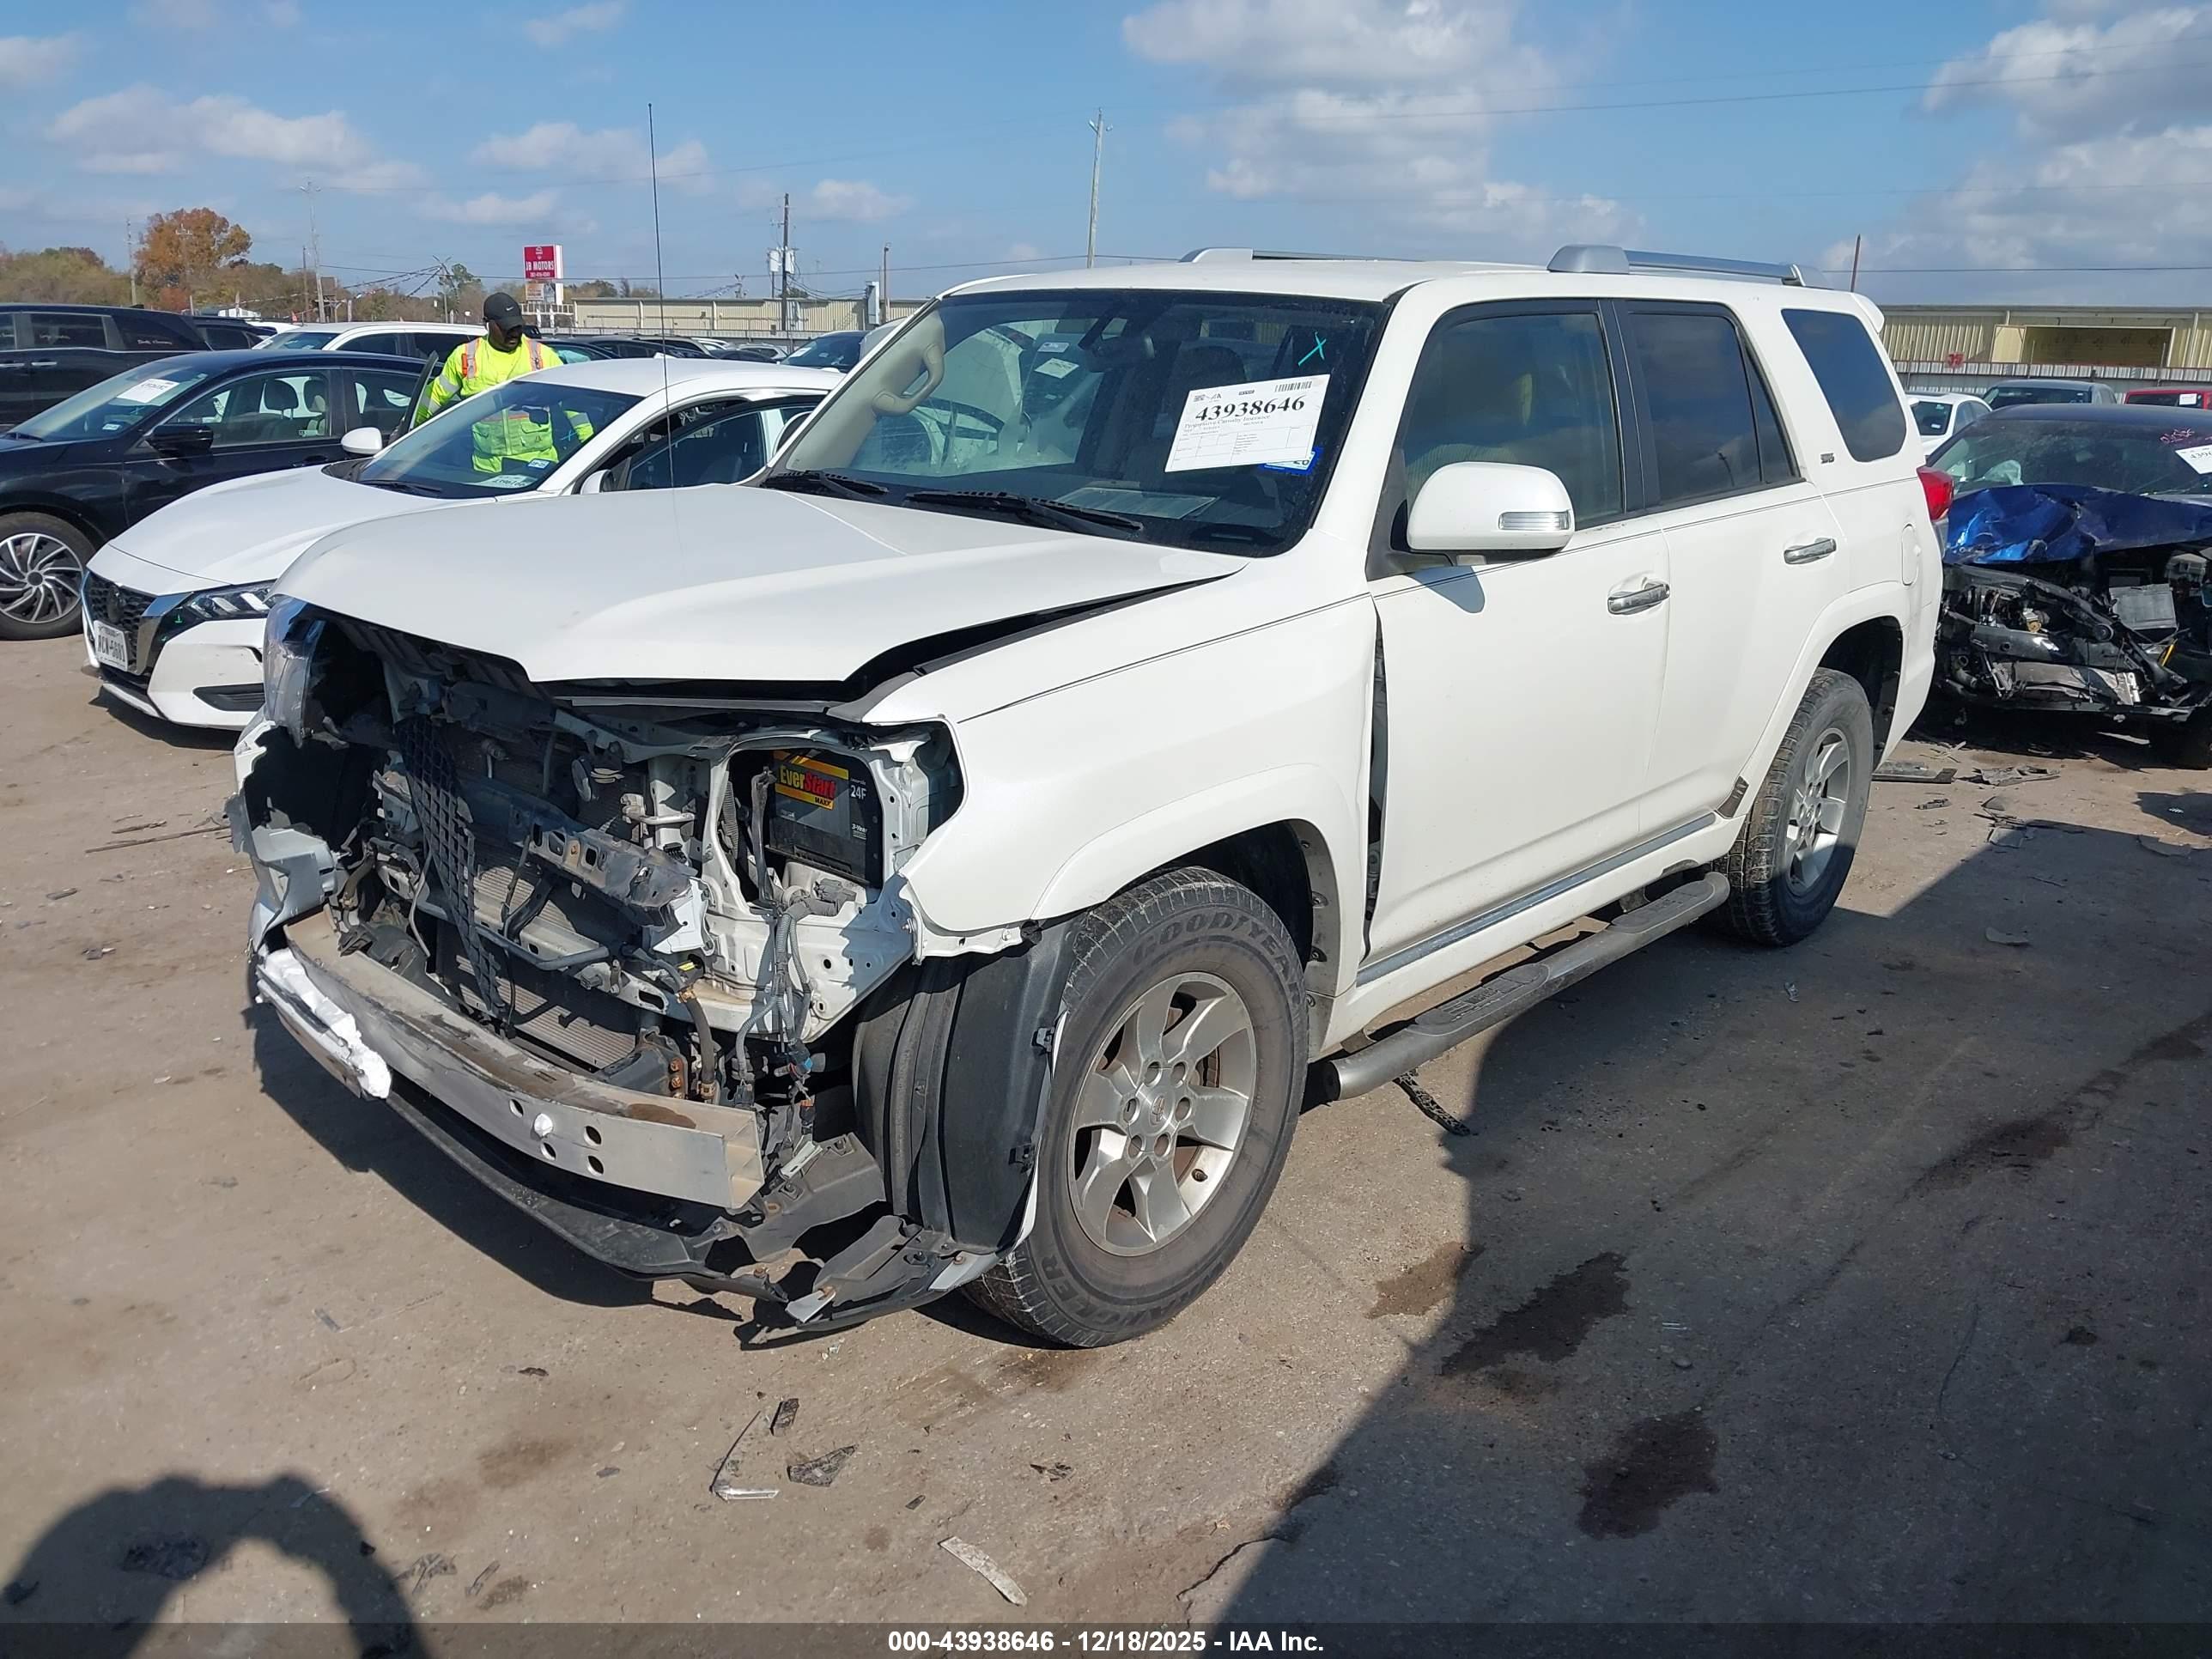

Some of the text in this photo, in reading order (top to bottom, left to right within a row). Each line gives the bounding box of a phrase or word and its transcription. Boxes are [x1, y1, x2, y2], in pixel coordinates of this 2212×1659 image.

[526, 261, 554, 270] JB MOTORS
[1195, 394, 1307, 422] 43938646
[780, 766, 837, 799] EverStart
[850, 784, 866, 799] 24F
[814, 796, 832, 807] MAXX
[851, 823, 867, 832] 3-Year
[1133, 911, 1304, 1006] GOODYEAR
